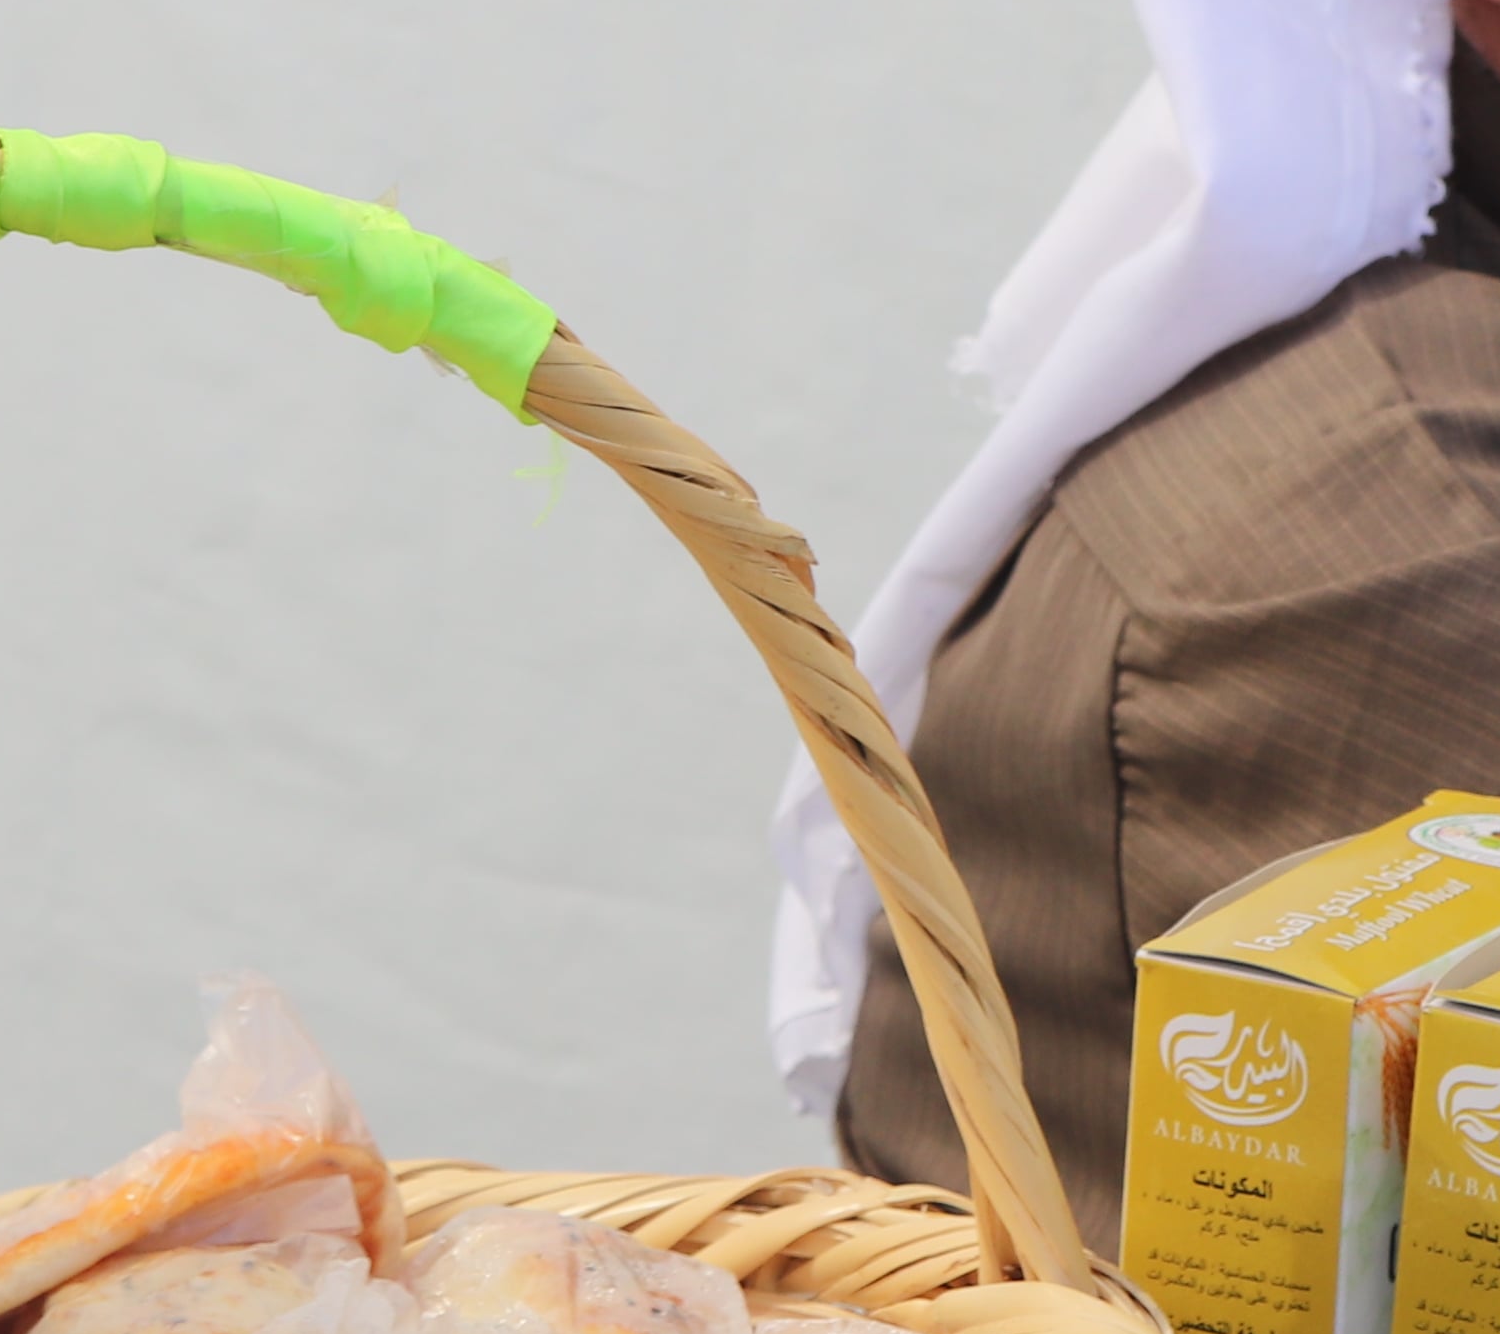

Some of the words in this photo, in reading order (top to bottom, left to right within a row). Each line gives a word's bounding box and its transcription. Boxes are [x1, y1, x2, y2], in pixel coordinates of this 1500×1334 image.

[1326, 905, 1416, 951] Maftool
[1398, 878, 1472, 915] Wheat
[1154, 1118, 1307, 1166] ALBAYDAR
[1193, 1170, 1273, 1200] المكونات
